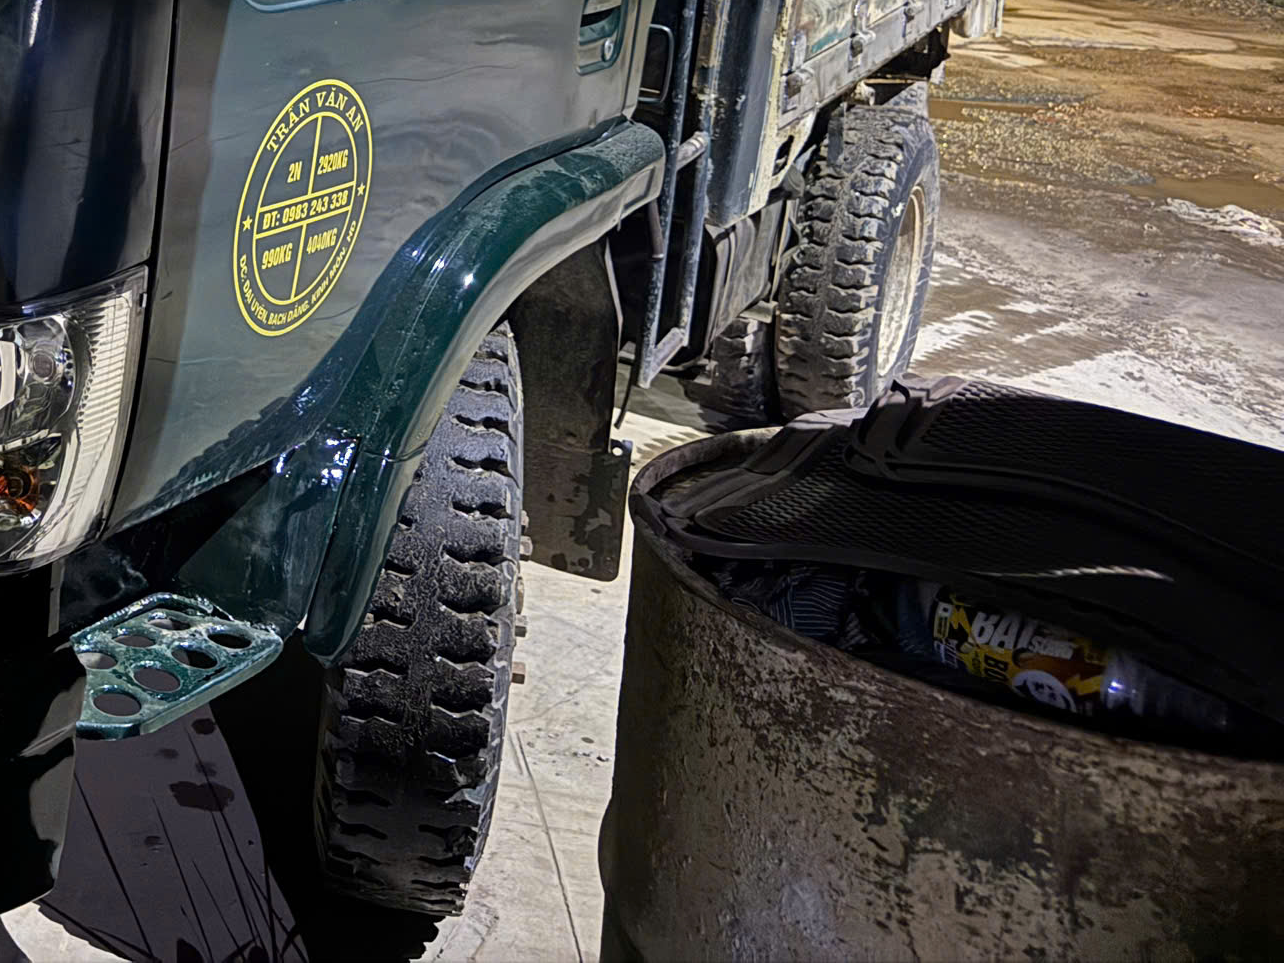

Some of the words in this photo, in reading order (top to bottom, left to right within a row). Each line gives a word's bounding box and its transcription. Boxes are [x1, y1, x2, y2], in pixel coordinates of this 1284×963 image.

[316, 86, 349, 112] VĂN
[345, 105, 365, 133] AN
[286, 160, 303, 184] 2N
[261, 242, 293, 270] 990KG
